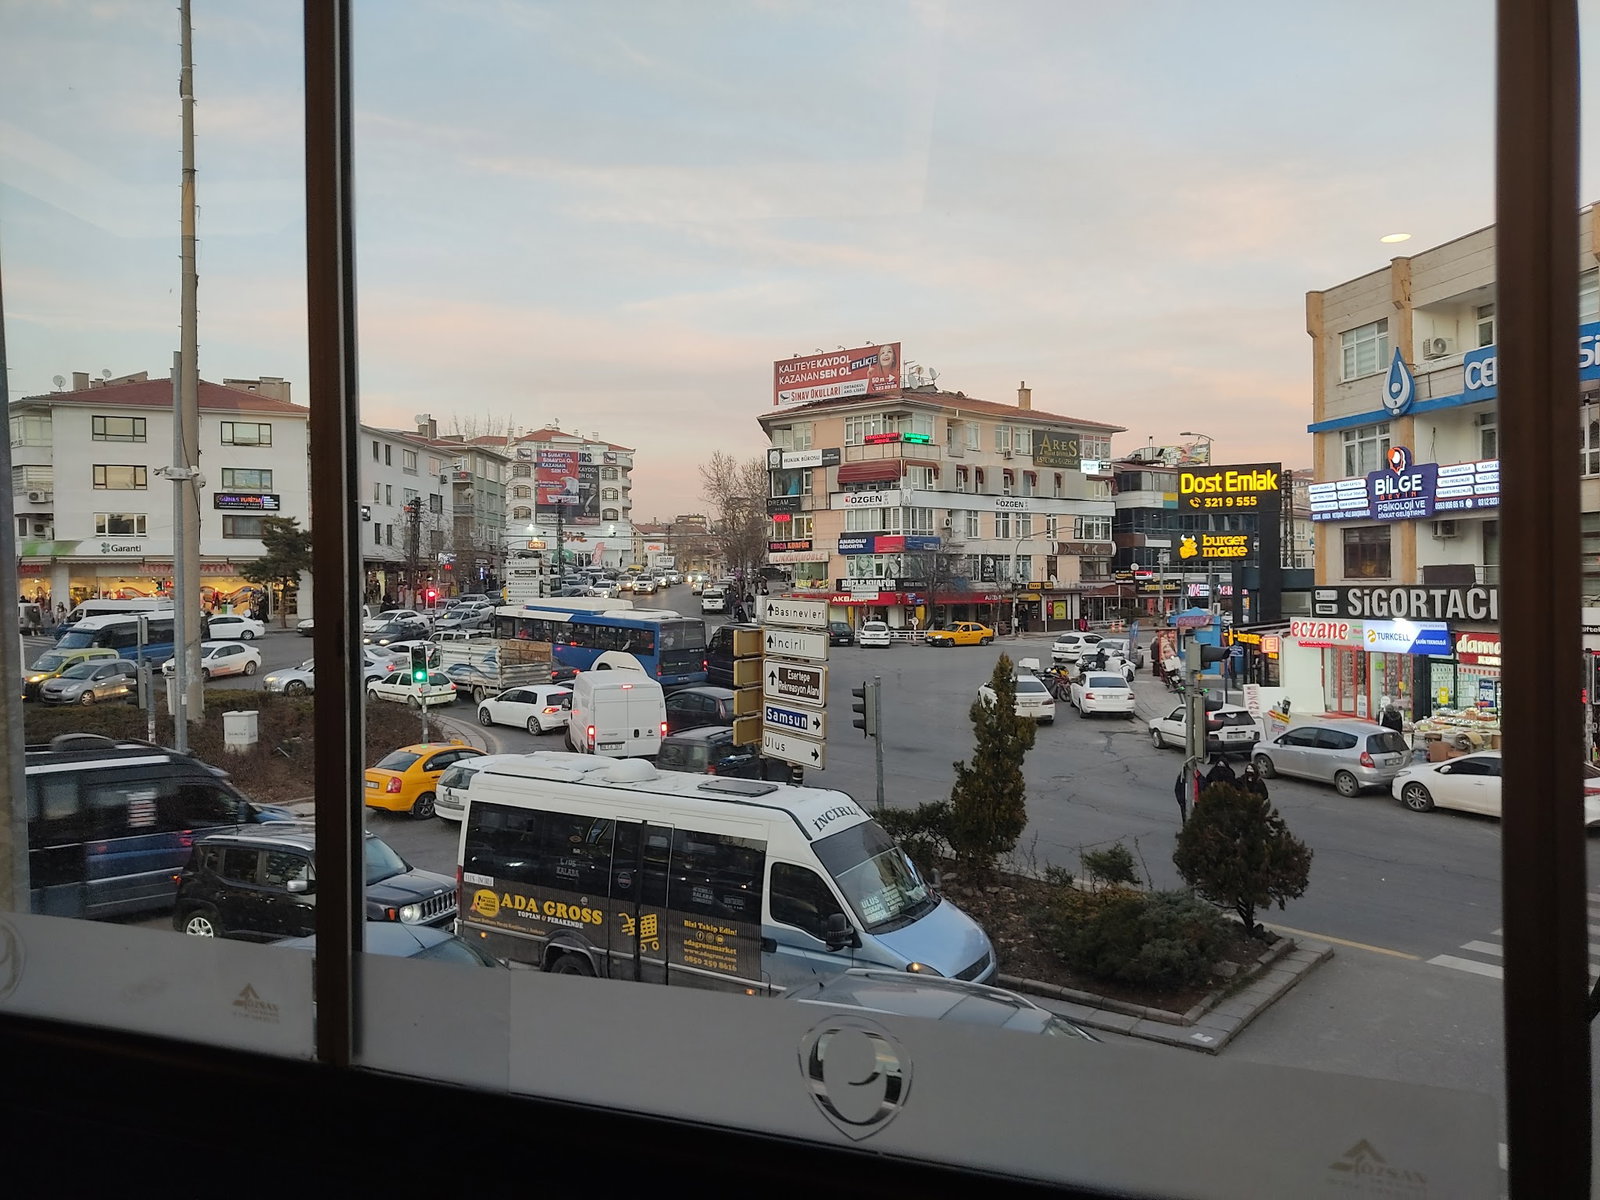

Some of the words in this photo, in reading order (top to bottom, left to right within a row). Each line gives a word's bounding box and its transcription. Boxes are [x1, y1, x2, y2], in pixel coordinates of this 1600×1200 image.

[817, 354, 851, 368] KAYDOL
[779, 372, 819, 385] KAZANAN
[820, 370, 837, 379] SEN
[839, 367, 851, 377] OL
[1465, 357, 1498, 390] CE
[810, 387, 840, 399] OKULLARI
[1181, 472, 1222, 494] Dost
[1226, 470, 1278, 492] Emlak
[1375, 474, 1422, 495] BİLGE
[1204, 497, 1223, 507] 321
[1226, 497, 1233, 506] 9
[1236, 496, 1257, 506] 555
[1378, 499, 1414, 512] PSİKOLOJİ
[1415, 500, 1426, 508] VE
[111, 544, 142, 553] Garanti
[1202, 534, 1248, 549] burger
[1202, 546, 1248, 557] make
[774, 606, 825, 620] Basınevleri
[1291, 621, 1349, 640] eczane
[1377, 632, 1410, 642] TURKCELL
[774, 633, 806, 651] İncirli
[787, 669, 811, 682] Esertepe
[779, 680, 806, 696] Rekreasyon
[806, 686, 820, 696] Alanı
[766, 708, 807, 729] Samsun
[765, 736, 786, 752] Ulus
[500, 892, 538, 913] ADA
[543, 900, 603, 925] GROSS
[517, 910, 540, 921] TOPTAN
[547, 917, 584, 929] PERAKENDE
[684, 920, 696, 929] Bizi
[698, 922, 718, 933] Takip
[719, 926, 737, 936] Edin!
[684, 940, 737, 954] adagrossmarket
